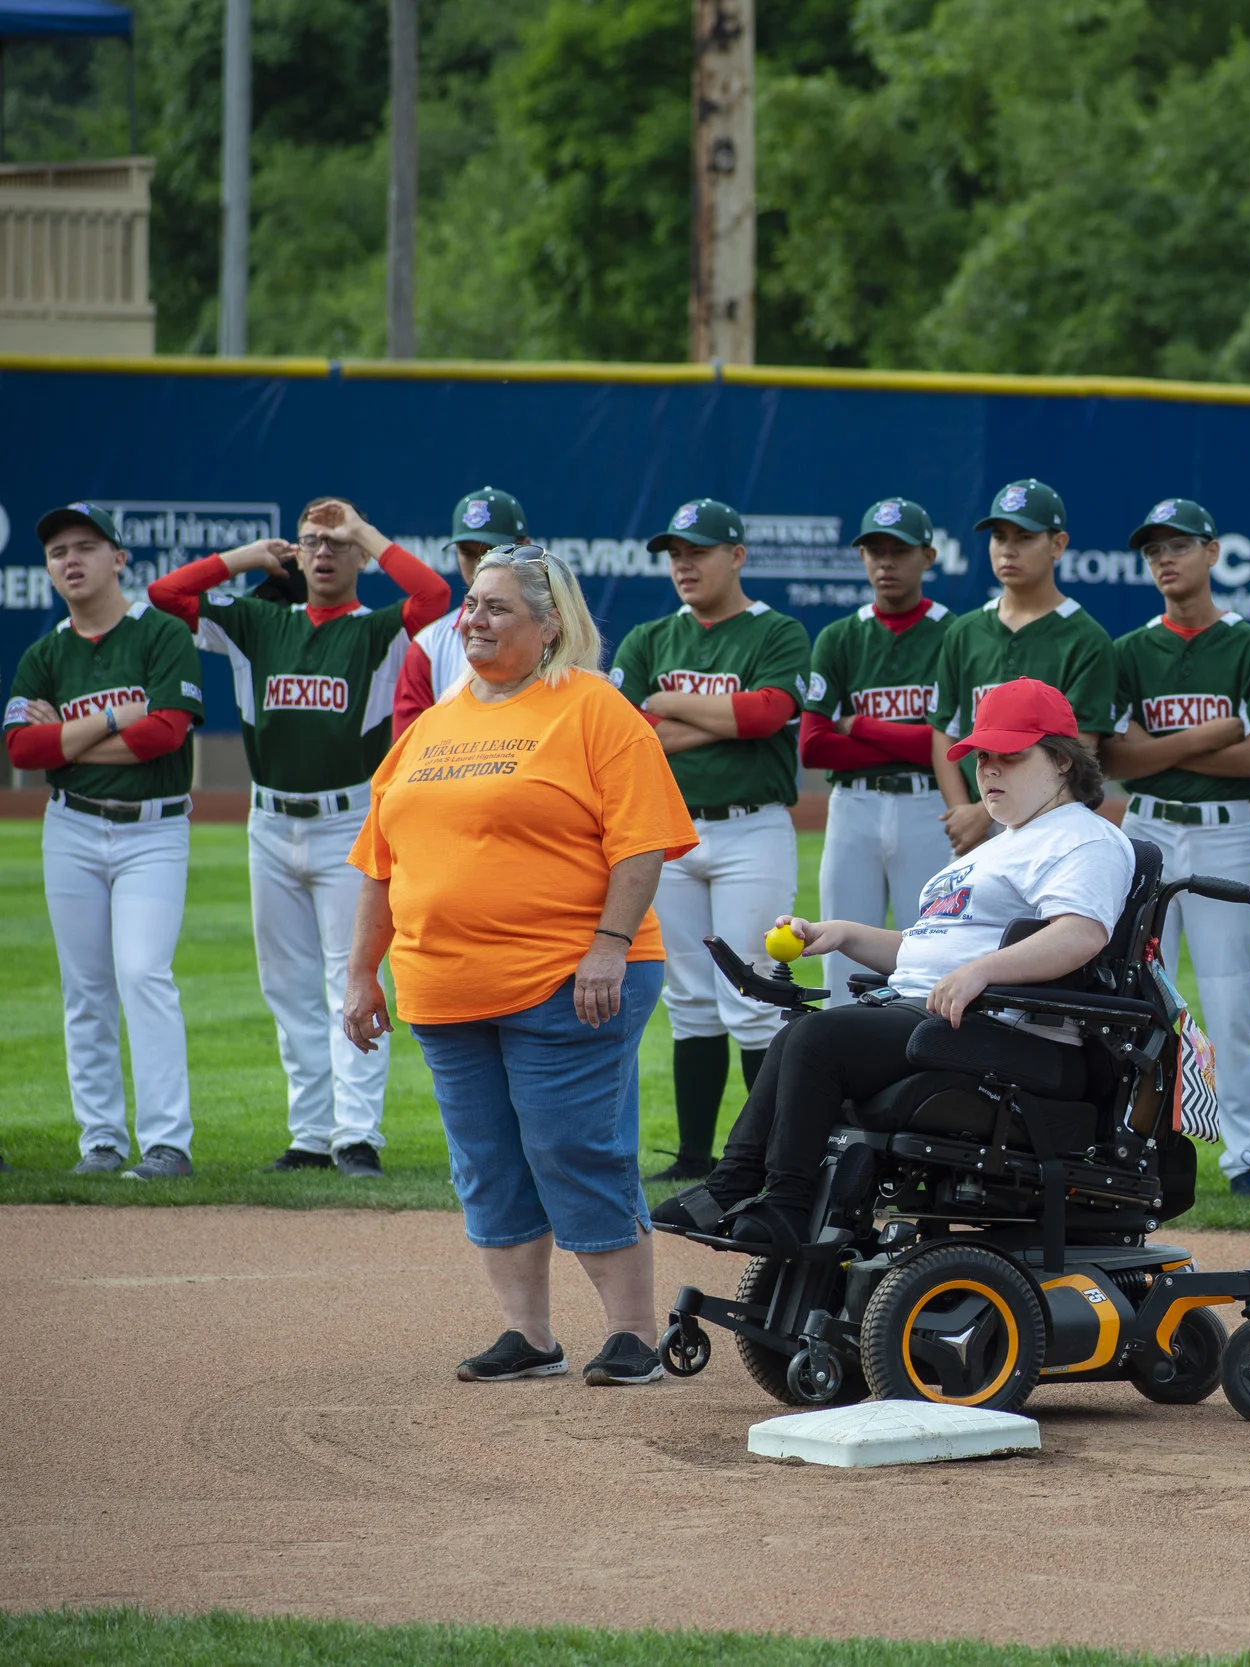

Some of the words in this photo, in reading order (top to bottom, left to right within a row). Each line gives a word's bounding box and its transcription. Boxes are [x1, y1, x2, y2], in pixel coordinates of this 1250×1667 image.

[112, 505, 270, 548] arthinsen
[263, 674, 349, 713] MEXICO
[1142, 694, 1233, 732] MEXICO
[419, 742, 479, 760] MIRACLE
[480, 738, 539, 752] LEAGUE
[408, 761, 518, 782] CHAMPIONS
[1082, 1287, 1107, 1304] F5
